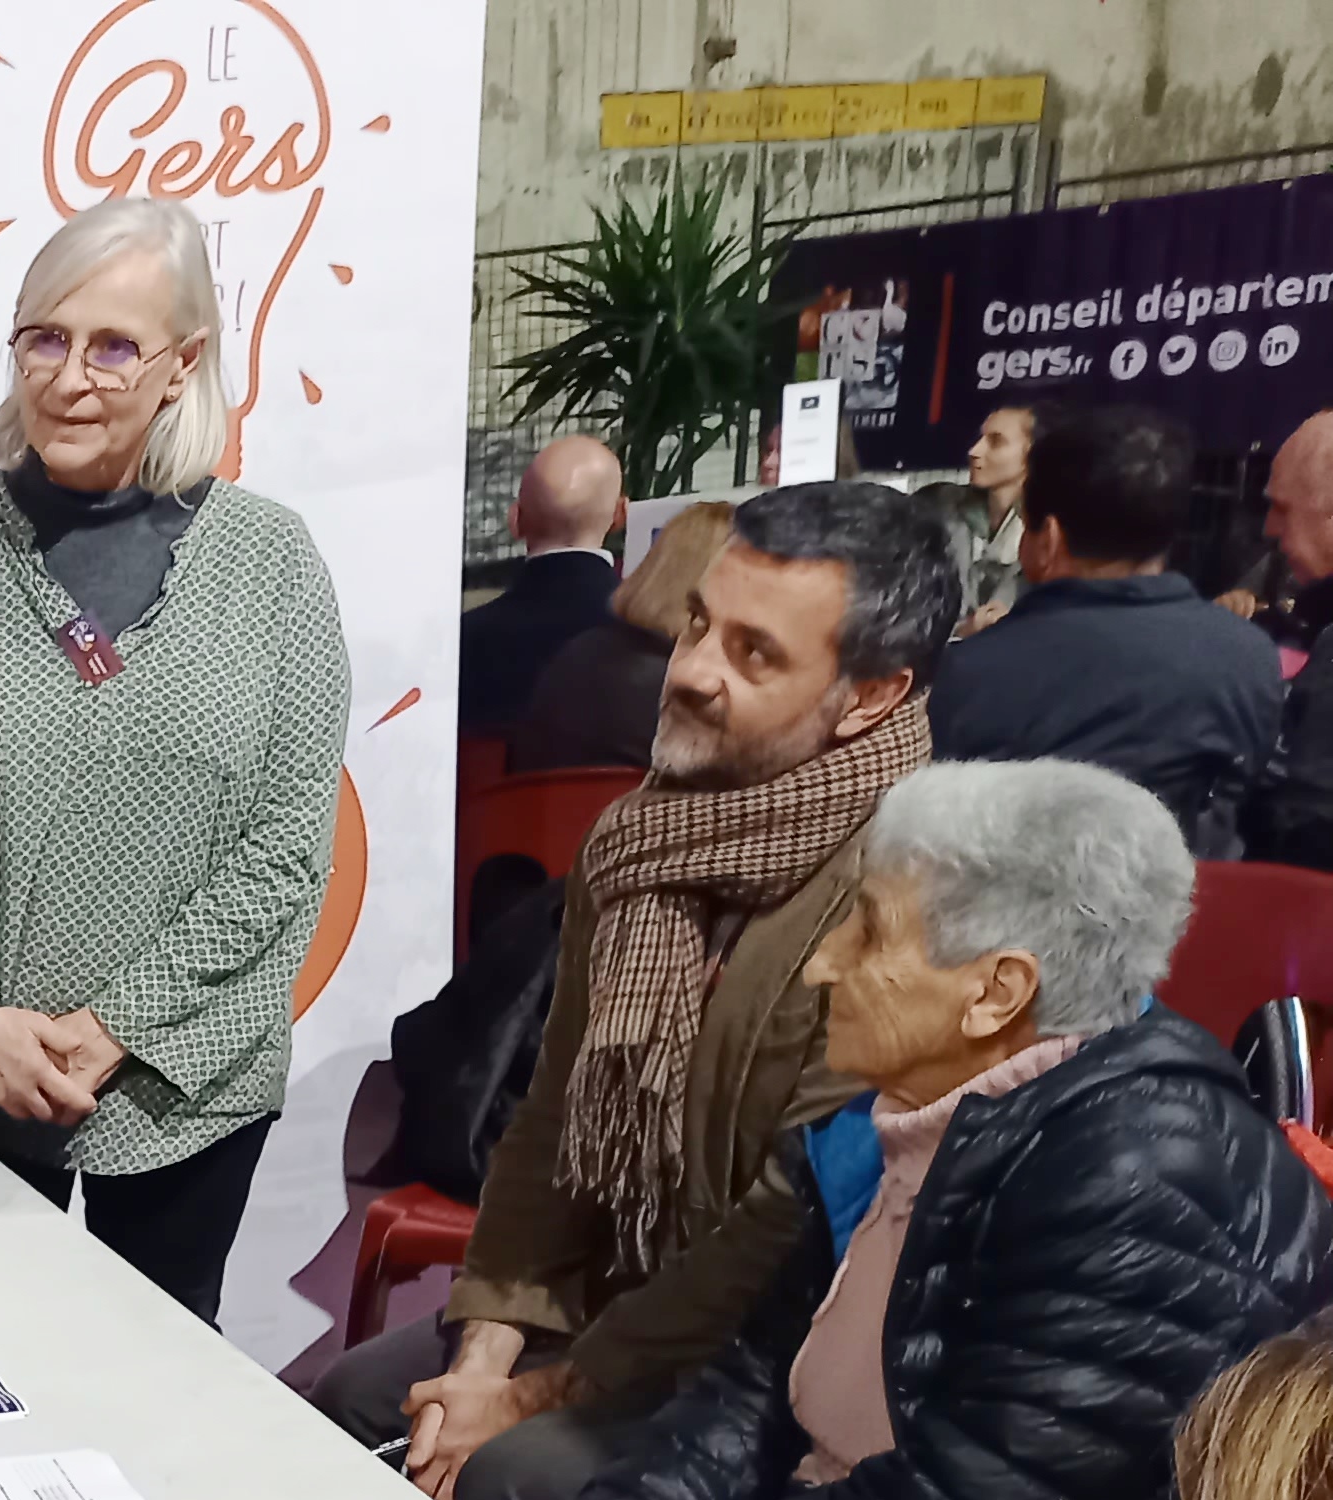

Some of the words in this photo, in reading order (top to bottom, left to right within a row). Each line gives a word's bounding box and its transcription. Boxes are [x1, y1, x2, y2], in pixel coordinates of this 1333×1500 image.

[207, 25, 239, 82] LE
[74, 58, 305, 201] Gers
[983, 287, 1124, 336] Conseil
[977, 345, 1094, 390] gers.fr
